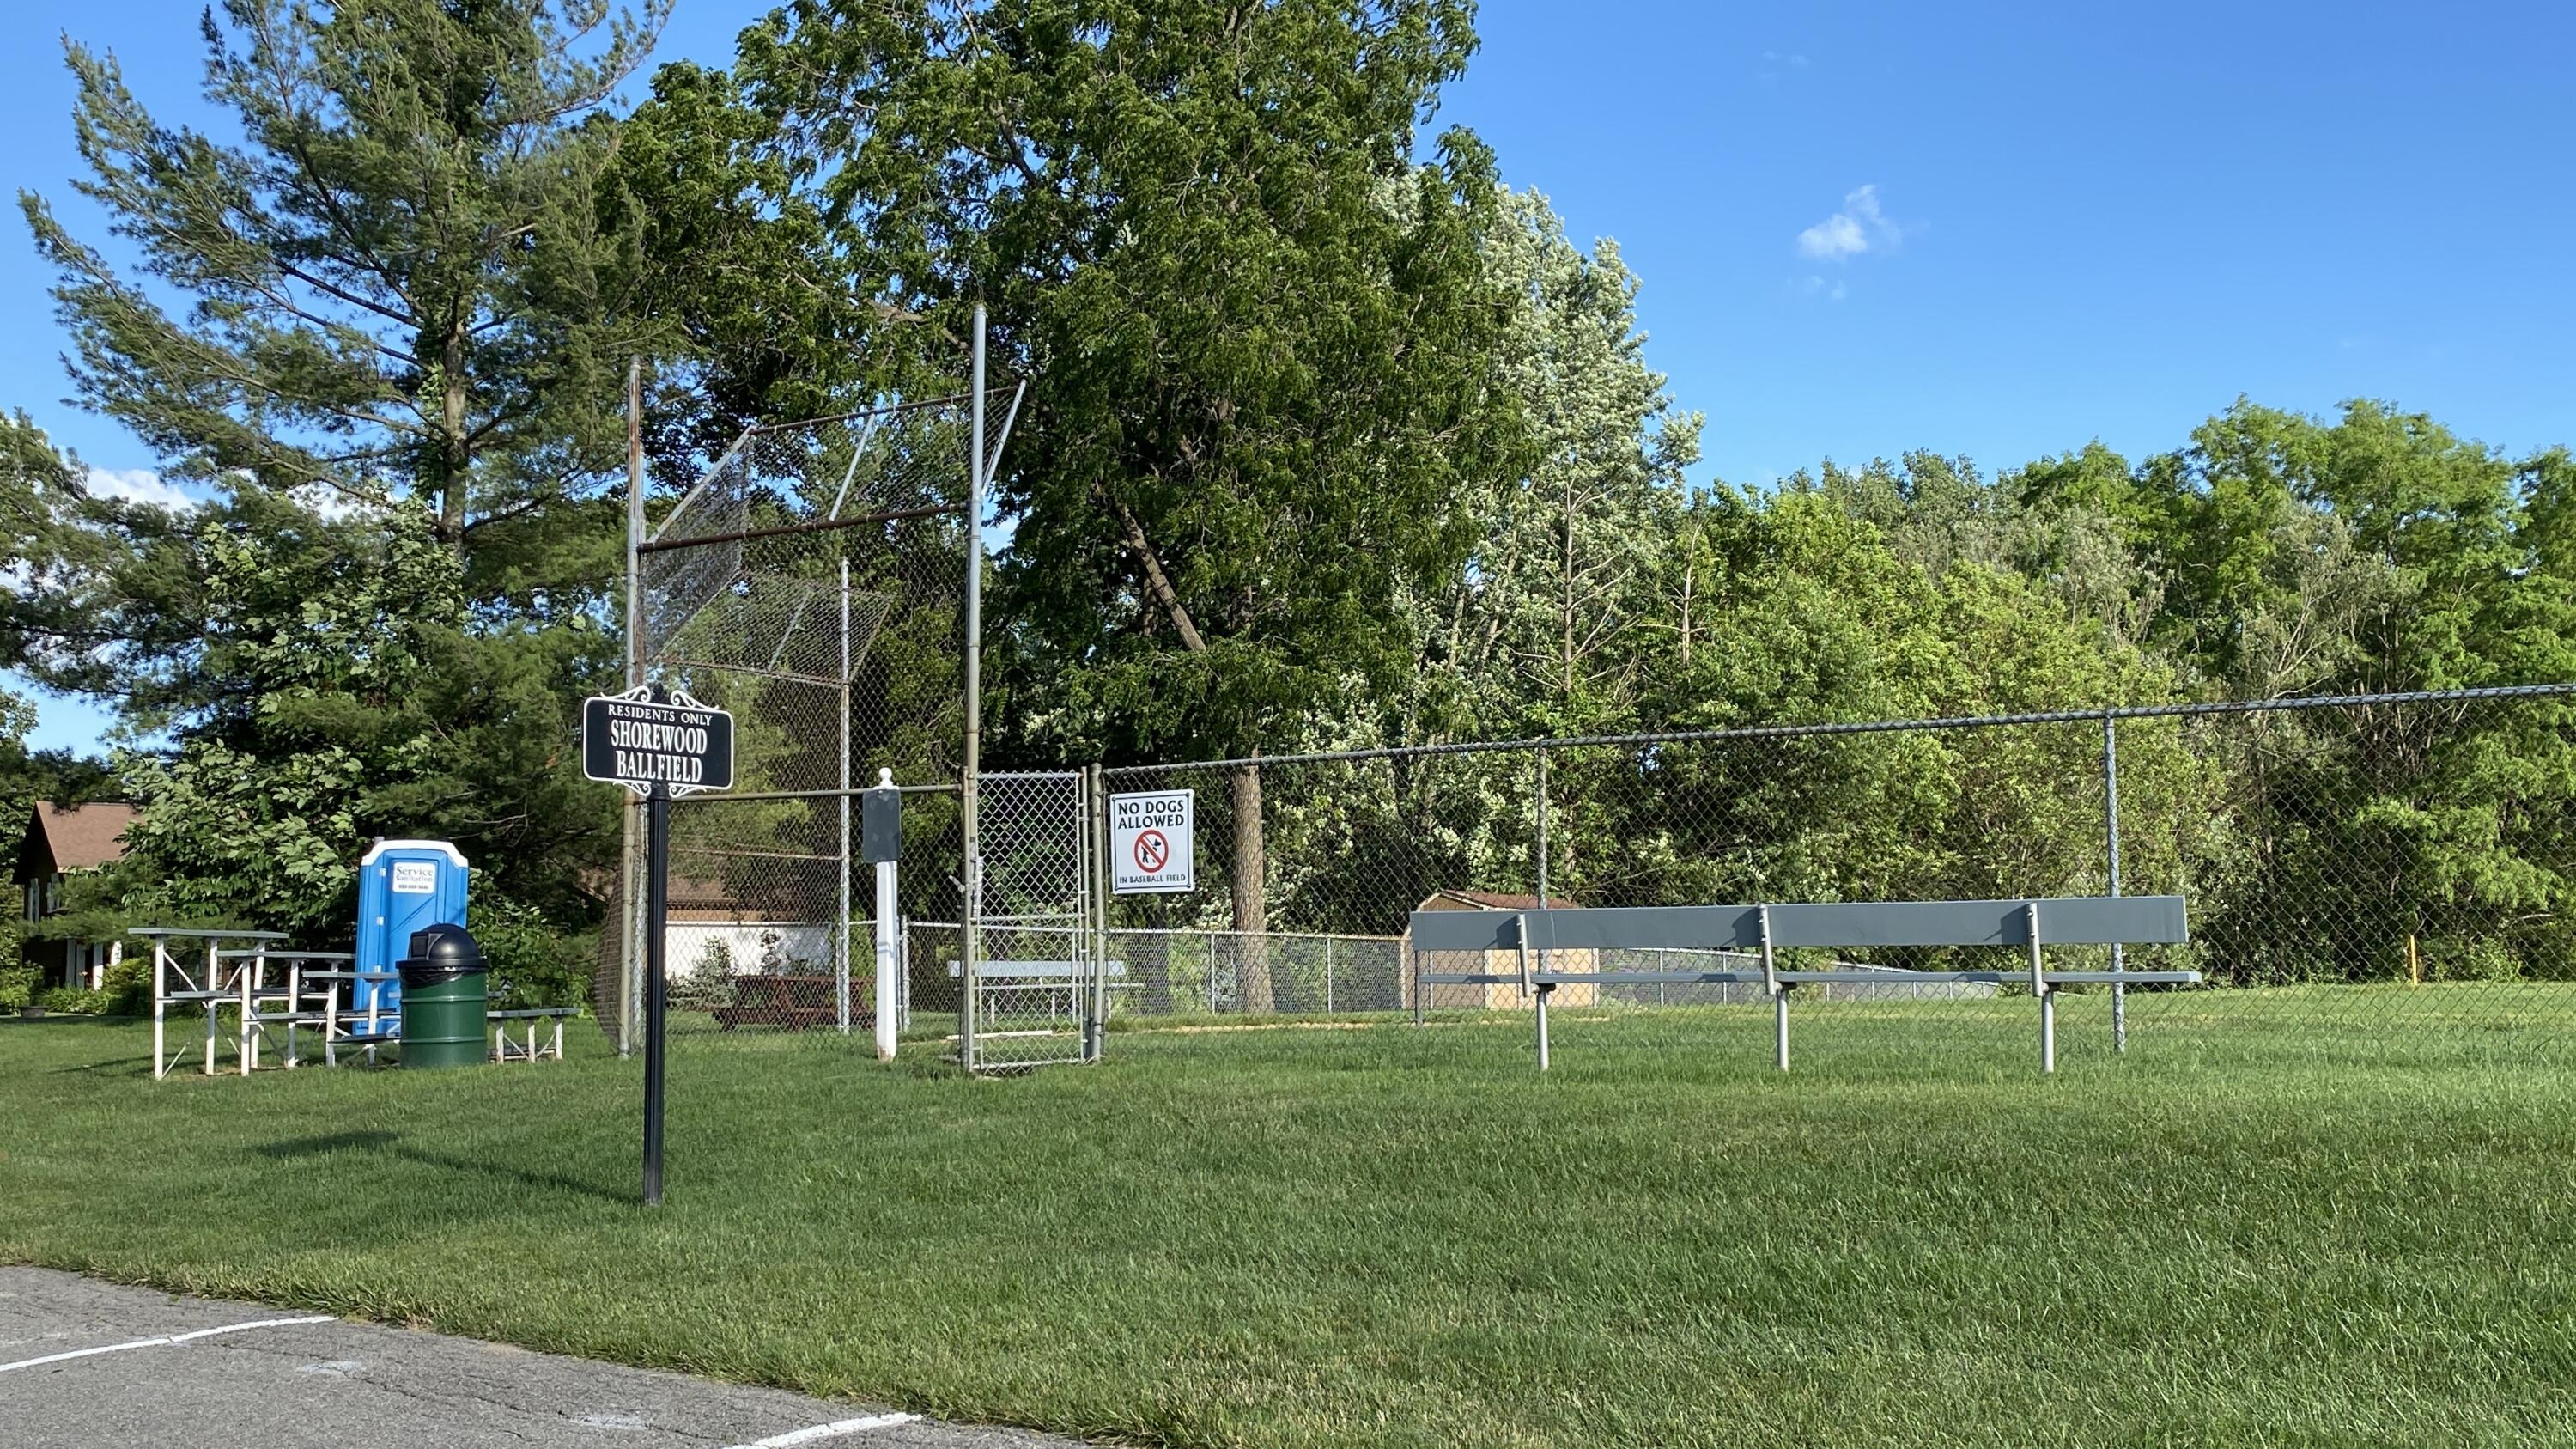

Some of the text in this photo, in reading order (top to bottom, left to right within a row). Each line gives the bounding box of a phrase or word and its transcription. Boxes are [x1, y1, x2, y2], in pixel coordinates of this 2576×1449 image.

[608, 704, 714, 727] RESIDENTS ONLY
[611, 719, 708, 755] SHOREWOOD
[616, 750, 702, 783] BALLFIELD
[1118, 800, 1184, 815] NO DOGS
[1118, 814, 1184, 830] ALLOWED
[397, 866, 433, 876] Service
[1129, 874, 1163, 883] BASEBALL
